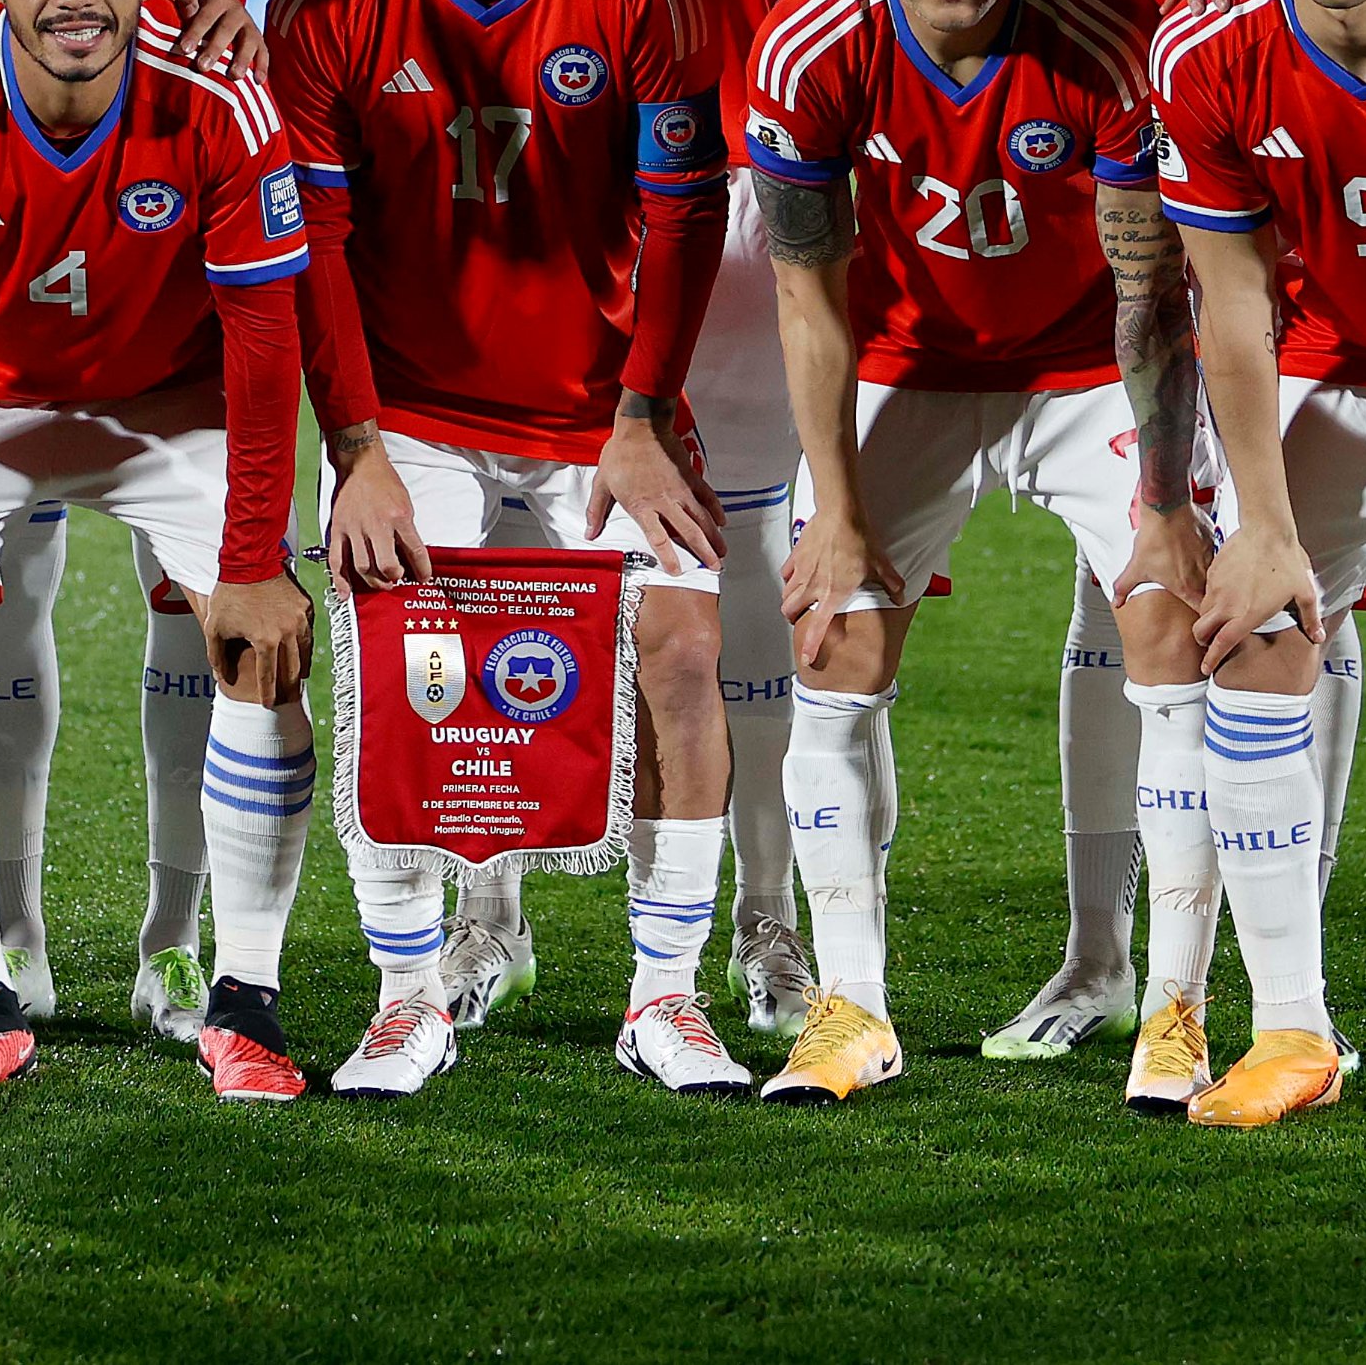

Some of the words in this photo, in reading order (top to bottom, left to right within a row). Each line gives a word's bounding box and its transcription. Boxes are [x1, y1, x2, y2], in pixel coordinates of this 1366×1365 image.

[446, 106, 532, 204] 17
[911, 175, 1029, 261] 20
[29, 250, 88, 316] 4
[490, 580, 597, 593] SUDAMERICANAS
[417, 589, 445, 598] COPA
[448, 591, 497, 602] MUNDIAL
[500, 593, 515, 602] DE
[518, 593, 533, 603] LA
[535, 594, 560, 604] FIFA
[404, 598, 447, 611] CANADÁ
[456, 601, 497, 614] MÉXICO
[507, 607, 545, 616] EE.UU.
[548, 608, 575, 617] 2026
[485, 631, 535, 671] FEDERACION
[537, 632, 551, 644] DE
[550, 637, 576, 674] FUTBOL
[506, 708, 521, 719] DE
[522, 709, 552, 721] CHILE
[431, 727, 535, 744] URUGUAY
[451, 760, 512, 776] CHILE
[442, 784, 486, 793] PRIMERA
[489, 785, 520, 794] FECHA
[422, 800, 429, 808] 8
[431, 800, 444, 809] DE
[446, 800, 502, 809] SEPTIEMBRE
[503, 801, 515, 809] DE
[516, 801, 540, 810] 2023
[439, 814, 471, 823] Estadio
[473, 814, 523, 825] Centenario,
[434, 825, 488, 836] Montevideo,
[490, 826, 525, 836] Uruguay.
